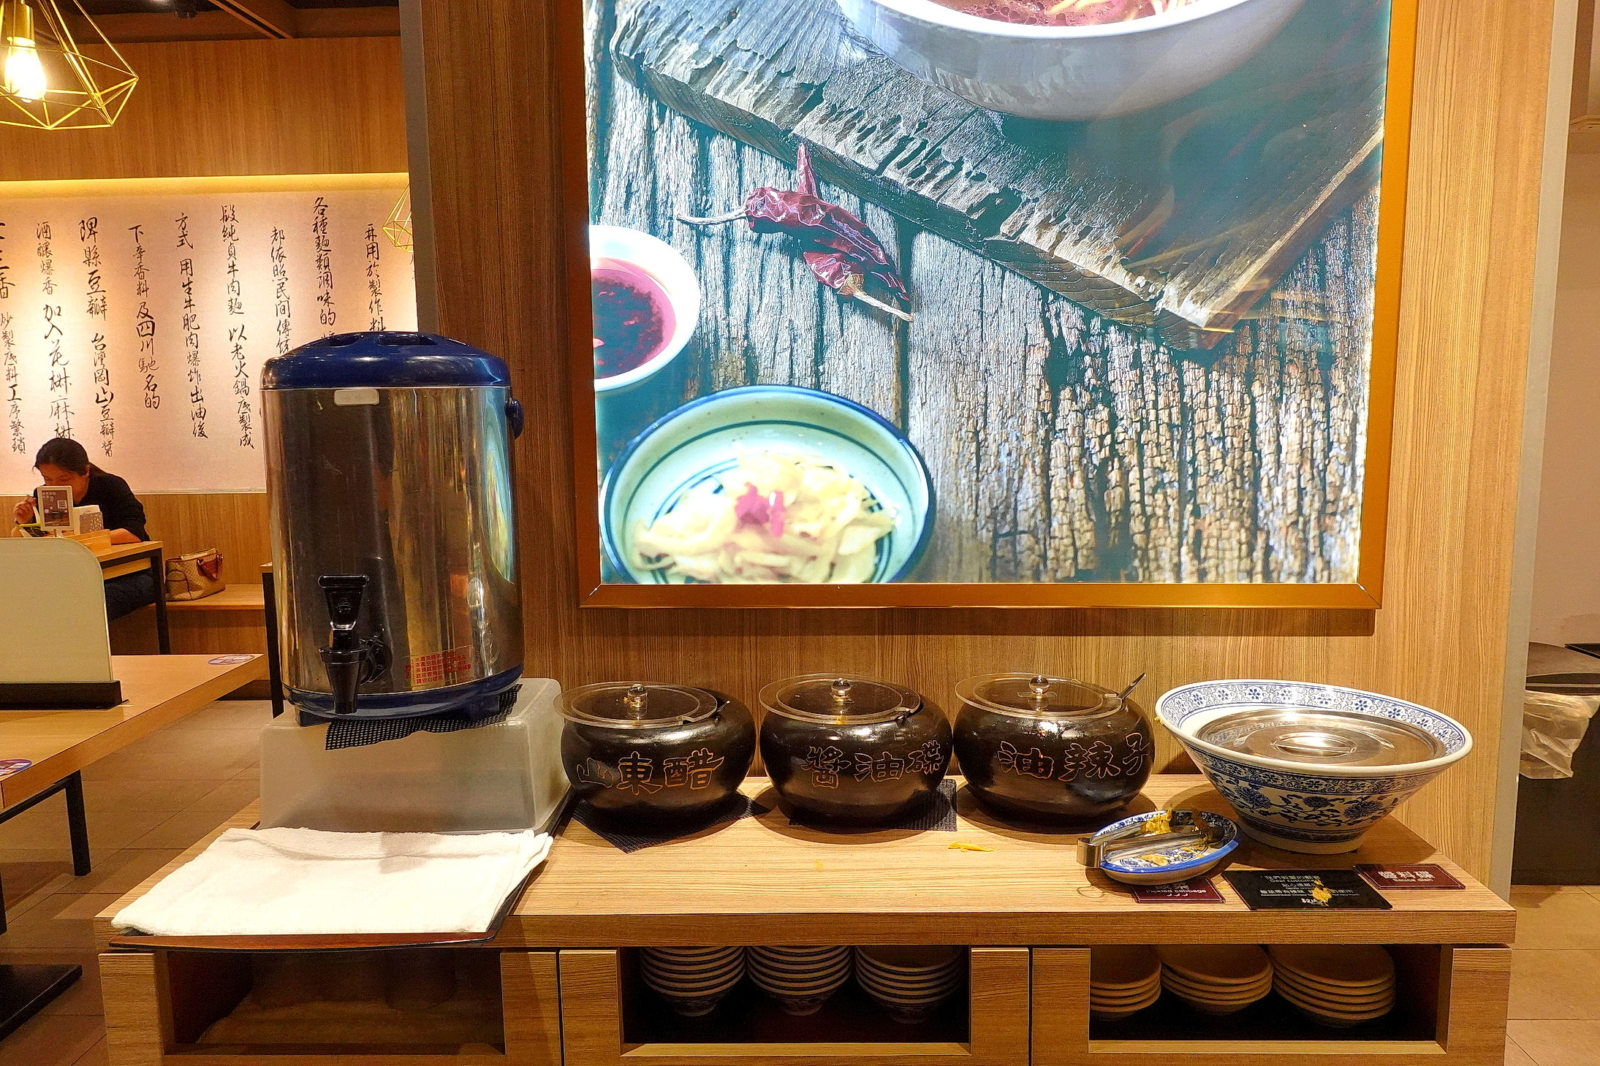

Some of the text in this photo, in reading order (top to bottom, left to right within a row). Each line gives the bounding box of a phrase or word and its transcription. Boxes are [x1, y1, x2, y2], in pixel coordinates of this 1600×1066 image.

[576, 747, 725, 796] 山東醋
[996, 732, 1151, 782] 油辣子
